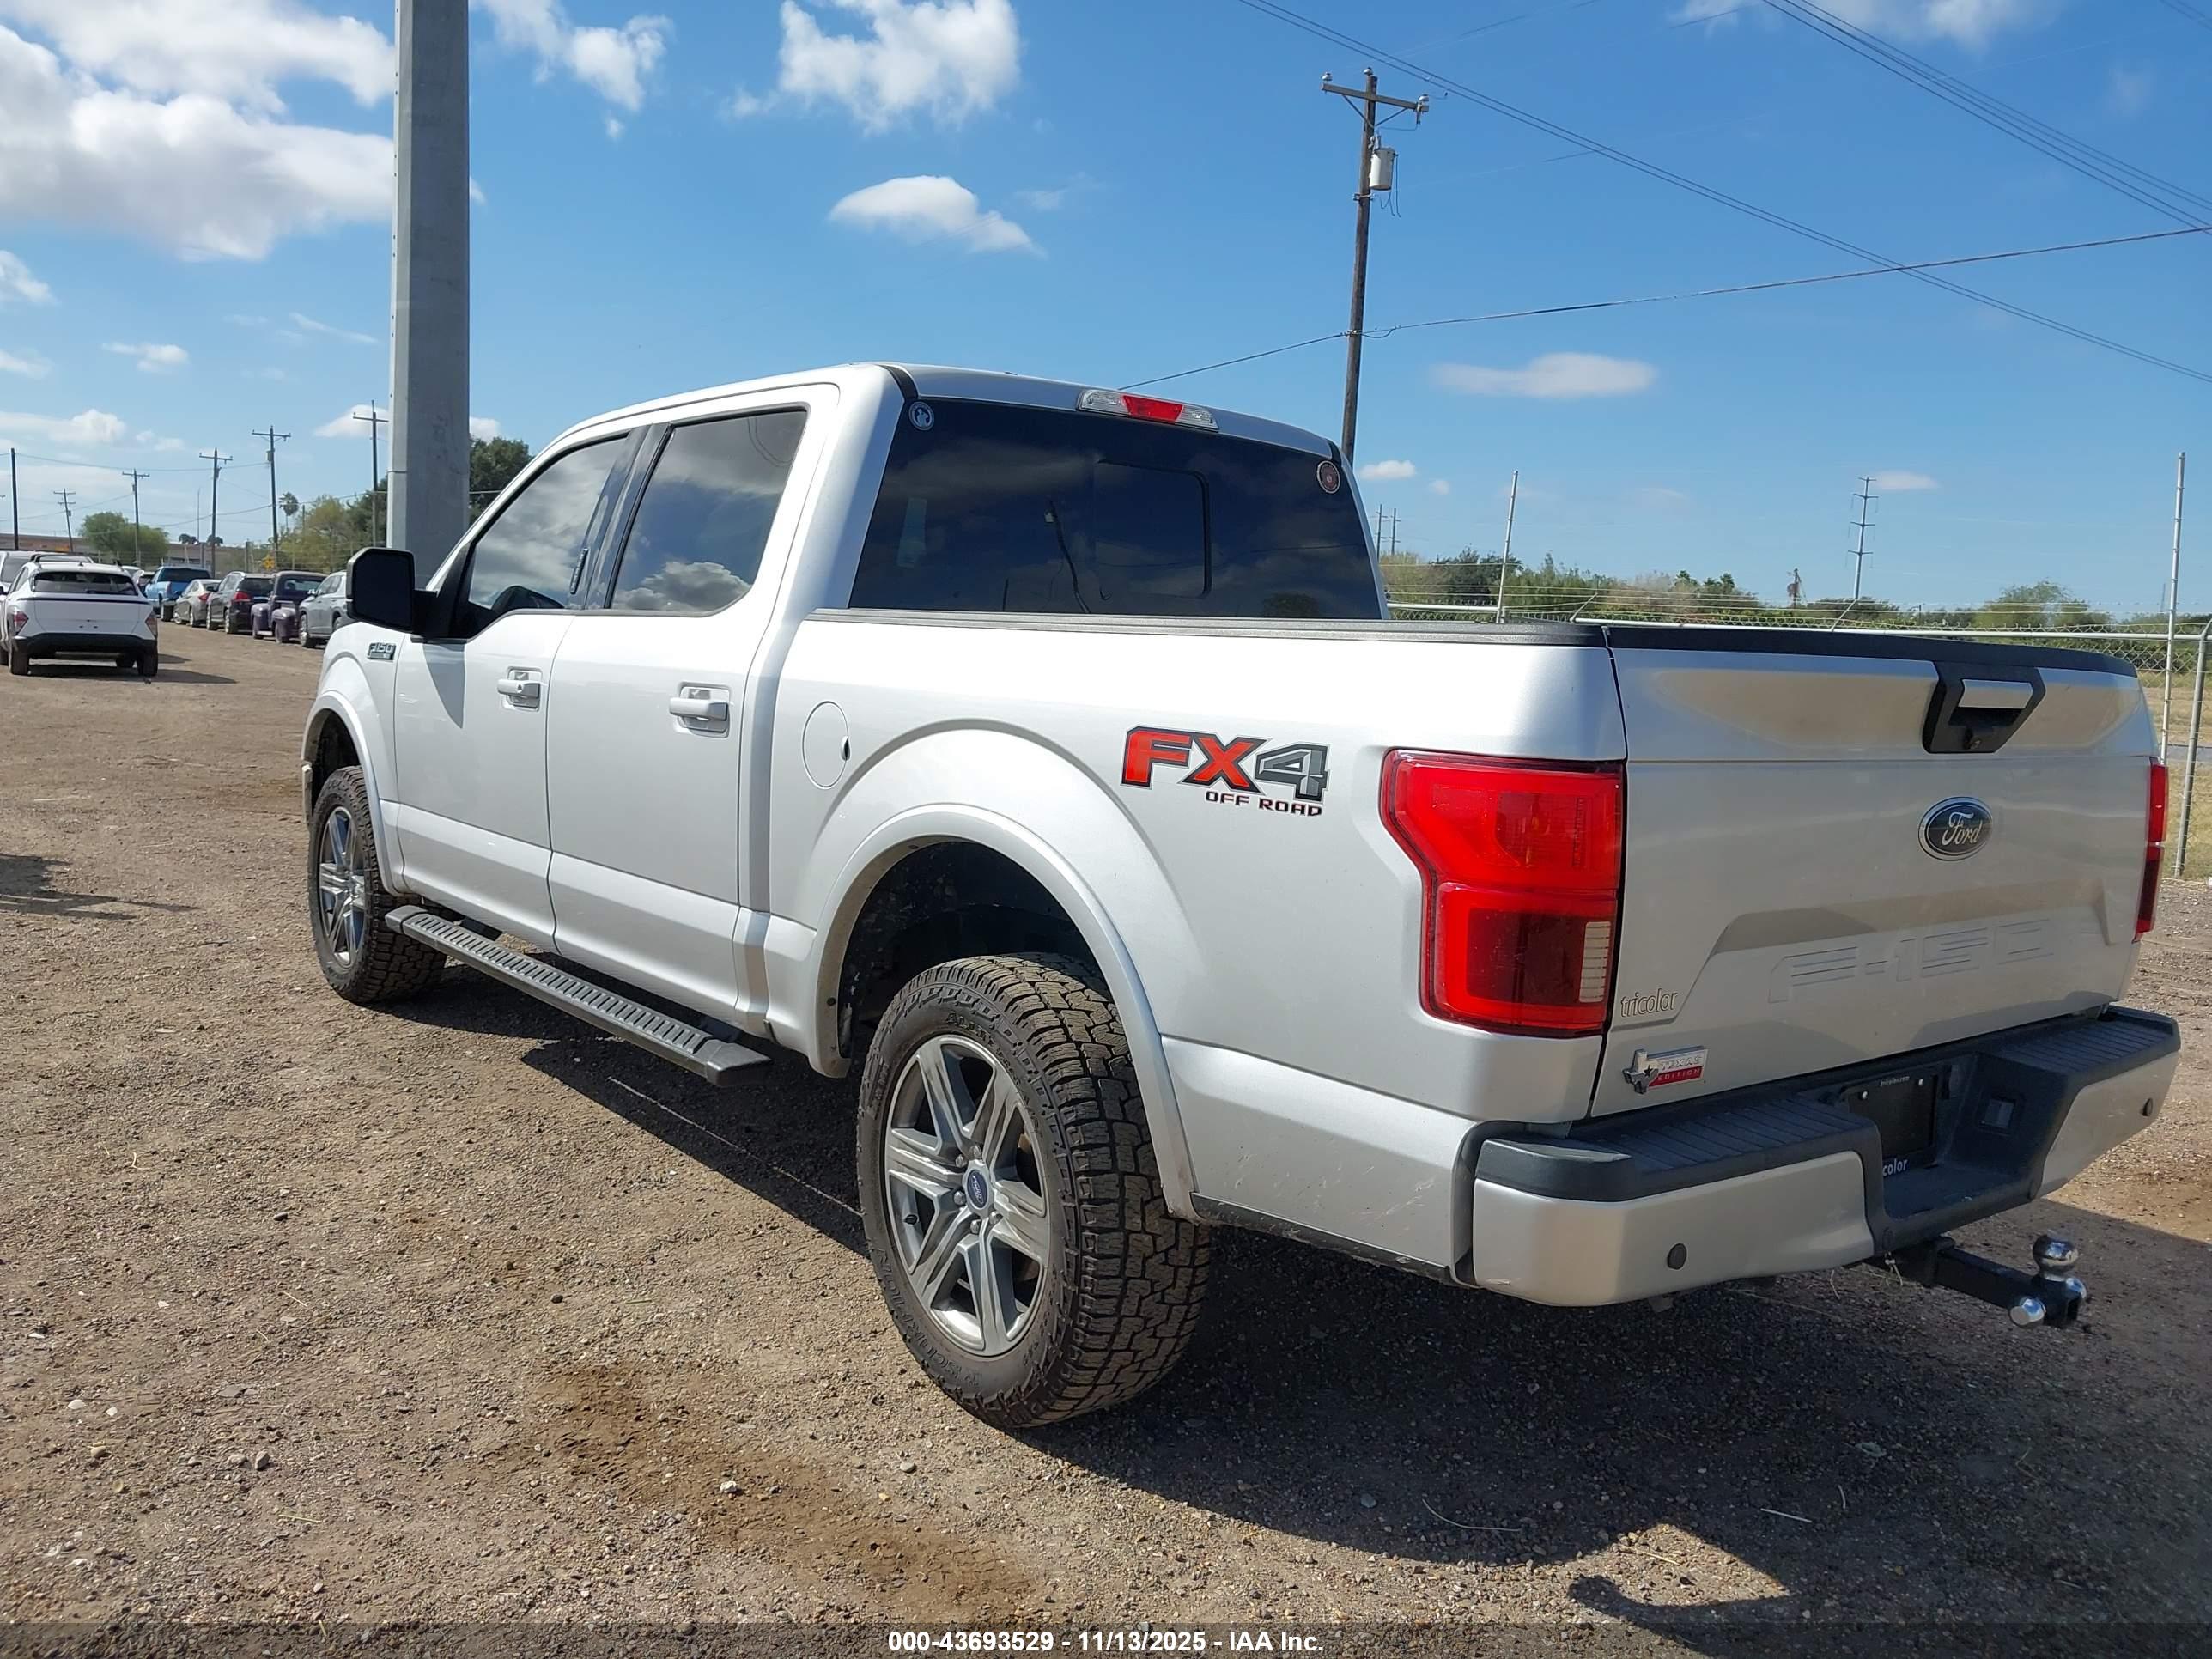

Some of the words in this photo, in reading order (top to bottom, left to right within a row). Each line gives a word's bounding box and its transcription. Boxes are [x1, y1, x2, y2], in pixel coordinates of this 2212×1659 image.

[1121, 726, 1329, 802] FX4
[1205, 790, 1250, 806] OFF
[1259, 798, 1323, 817] ROAD
[1941, 811, 1983, 846] Ford
[1620, 988, 1679, 1018] tricolor
[1657, 1067, 1701, 1081] EDITION
[1661, 1055, 1703, 1071] TEXAS
